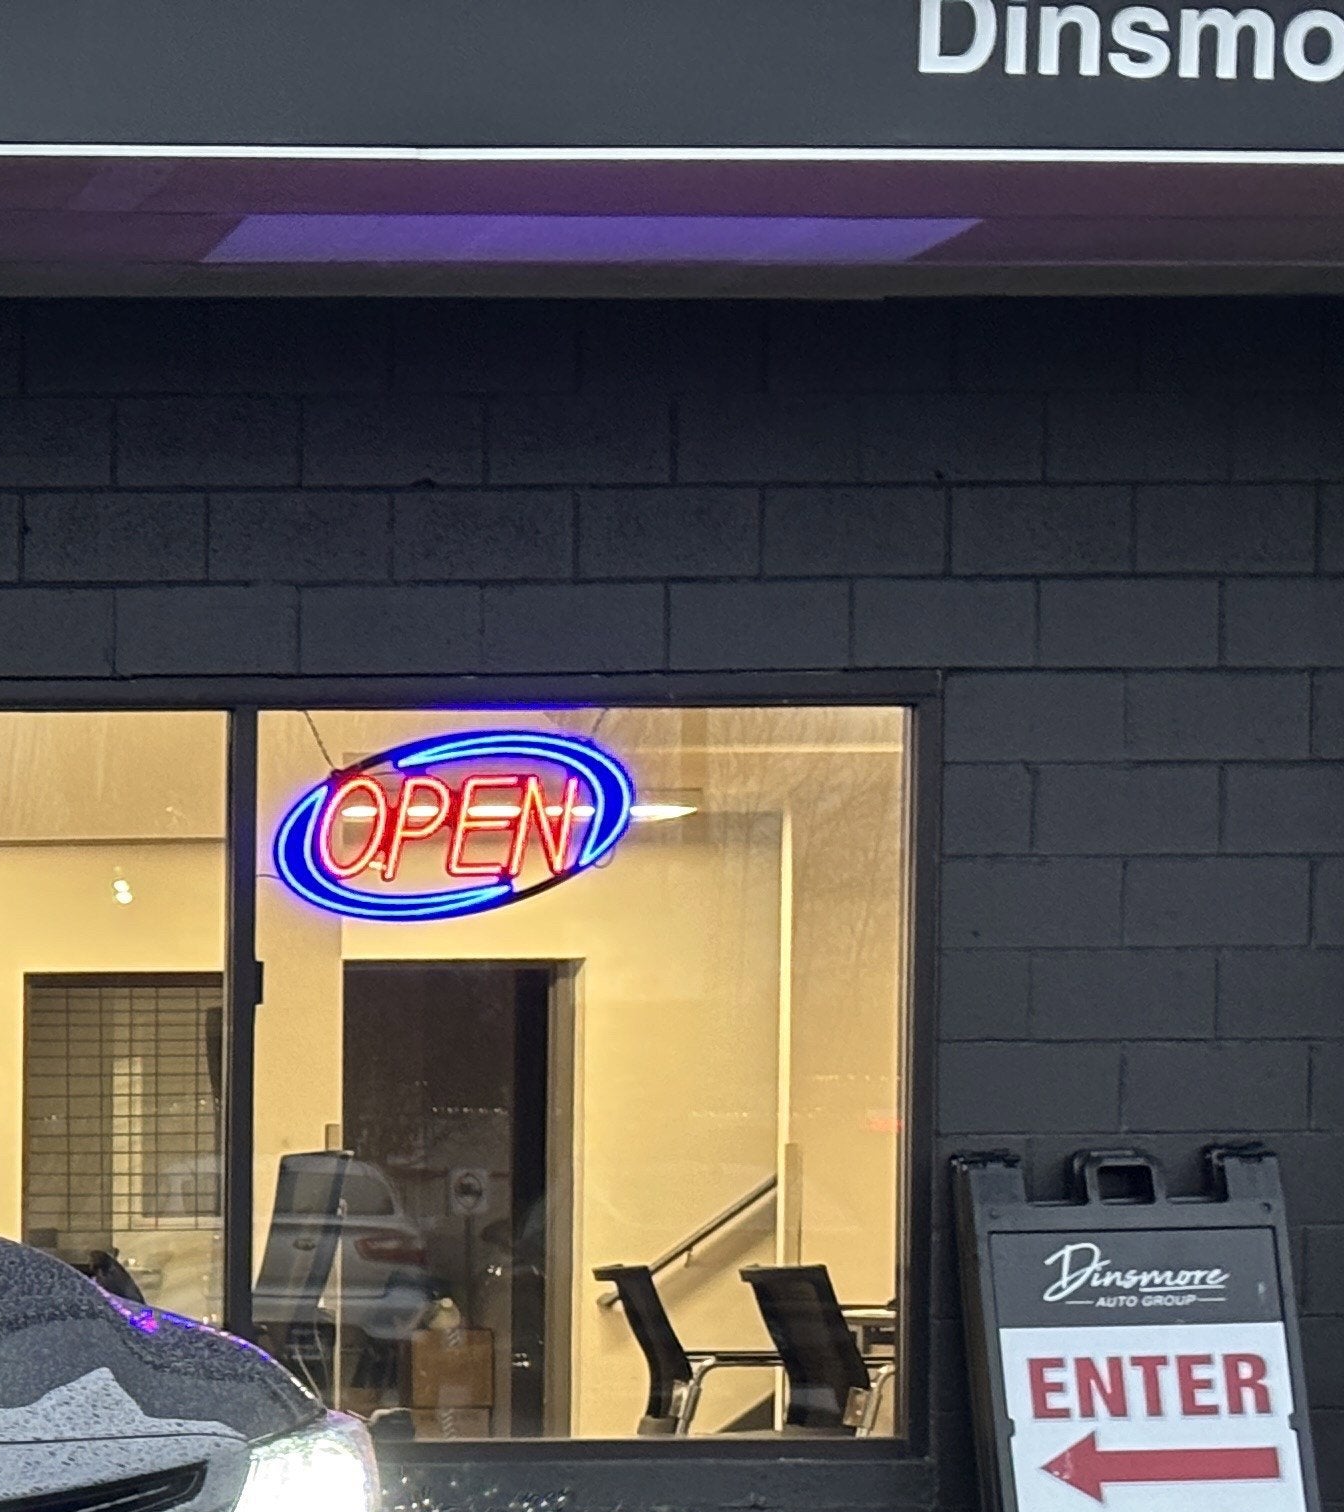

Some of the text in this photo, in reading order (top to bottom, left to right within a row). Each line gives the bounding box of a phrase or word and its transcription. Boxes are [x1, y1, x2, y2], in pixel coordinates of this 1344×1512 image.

[918, 0, 1344, 82] Dinsmo
[317, 774, 578, 881] OPEN
[1042, 1242, 1231, 1302] Dinsmore
[1095, 1294, 1197, 1307] AUTO GROUP
[1027, 1353, 1272, 1420] ENTER
